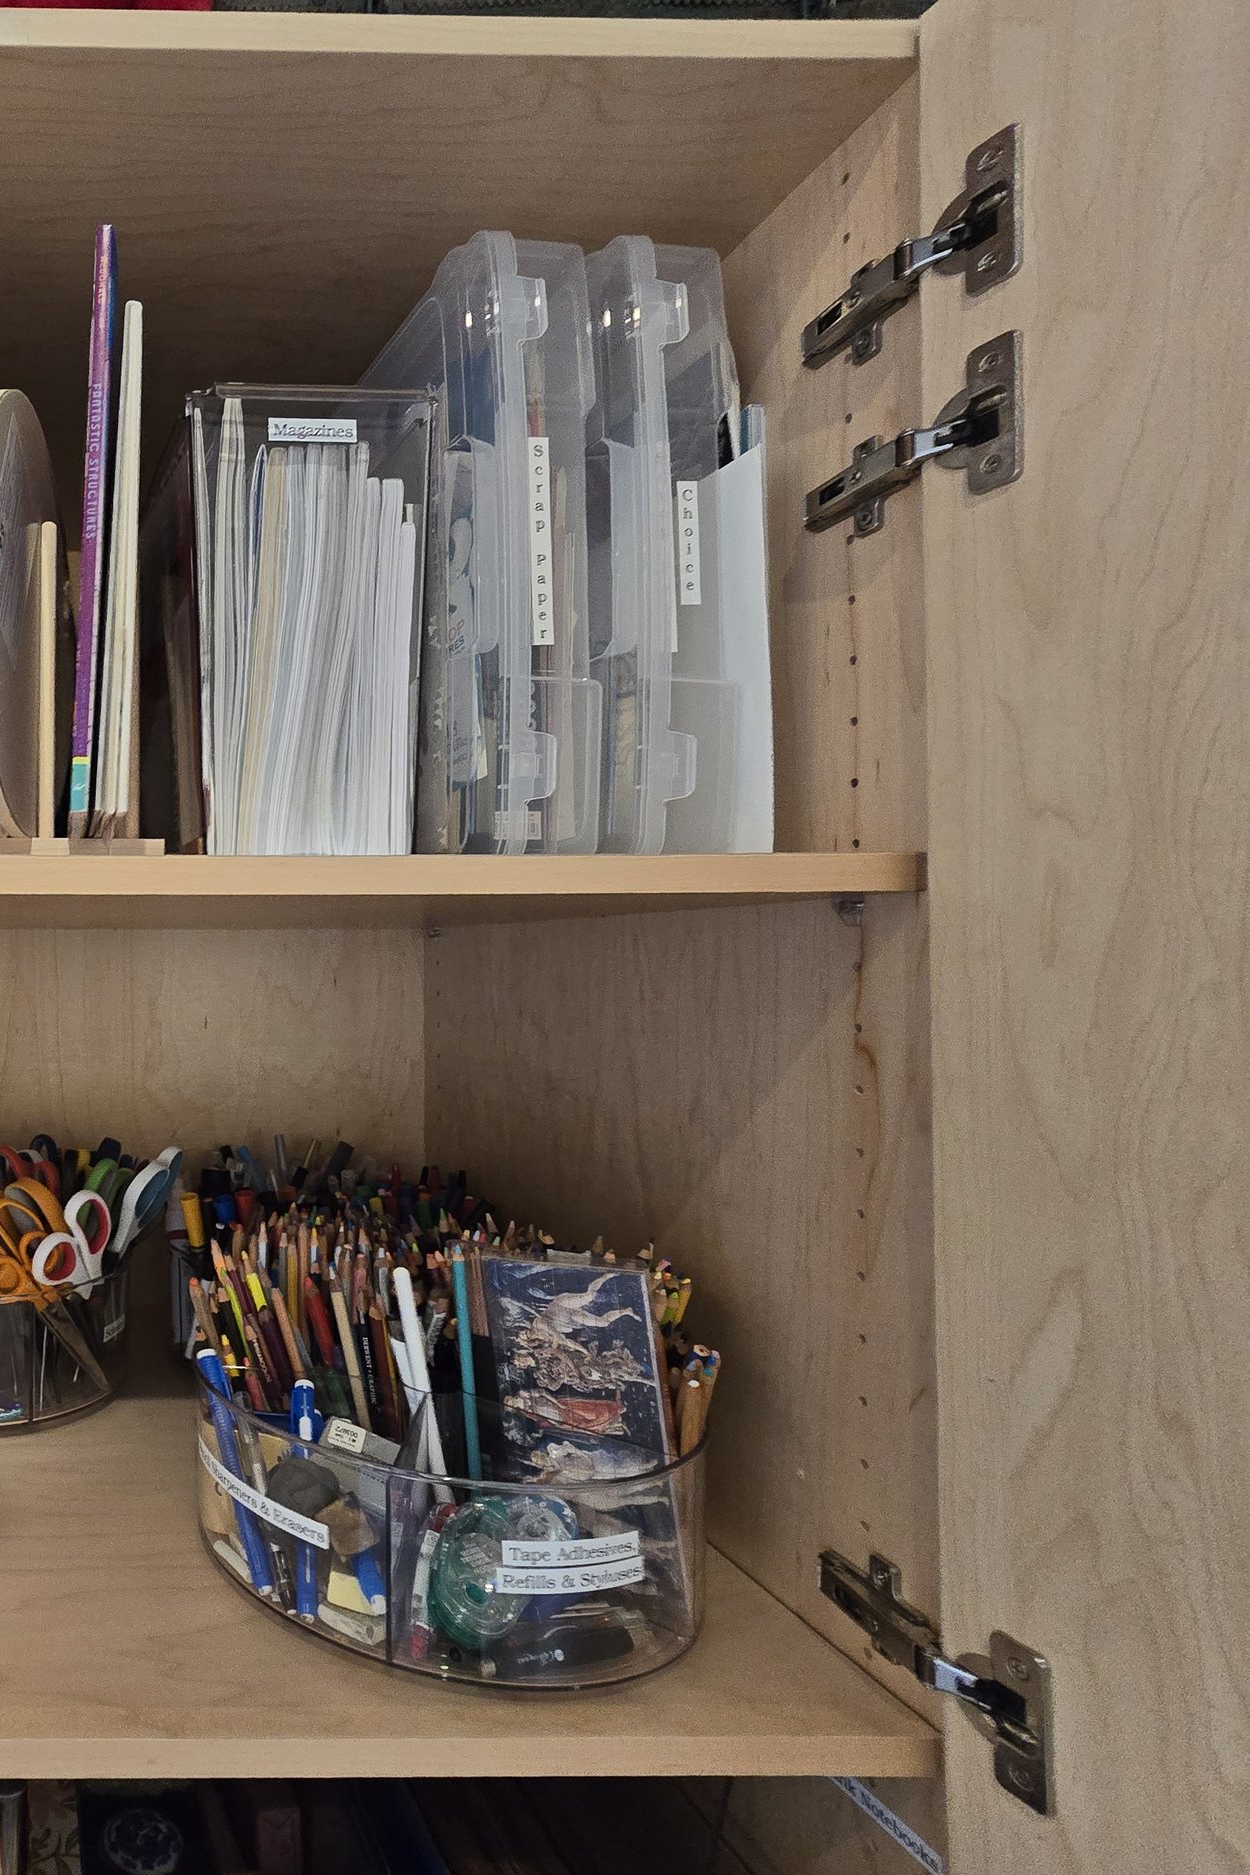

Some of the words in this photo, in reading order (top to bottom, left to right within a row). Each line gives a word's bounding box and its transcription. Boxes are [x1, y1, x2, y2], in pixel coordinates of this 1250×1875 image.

[89, 383, 101, 452] FANTASTIC
[273, 423, 354, 440] Magazines
[85, 457, 100, 540] STRUCTURES
[534, 444, 546, 533] Scrap
[682, 488, 695, 591] Choice
[272, 1507, 325, 1543] Erasers
[502, 1574, 556, 1590] Refills
[561, 1574, 576, 1588] &
[580, 1565, 641, 1589] Styluses
[508, 1547, 550, 1565] Tape
